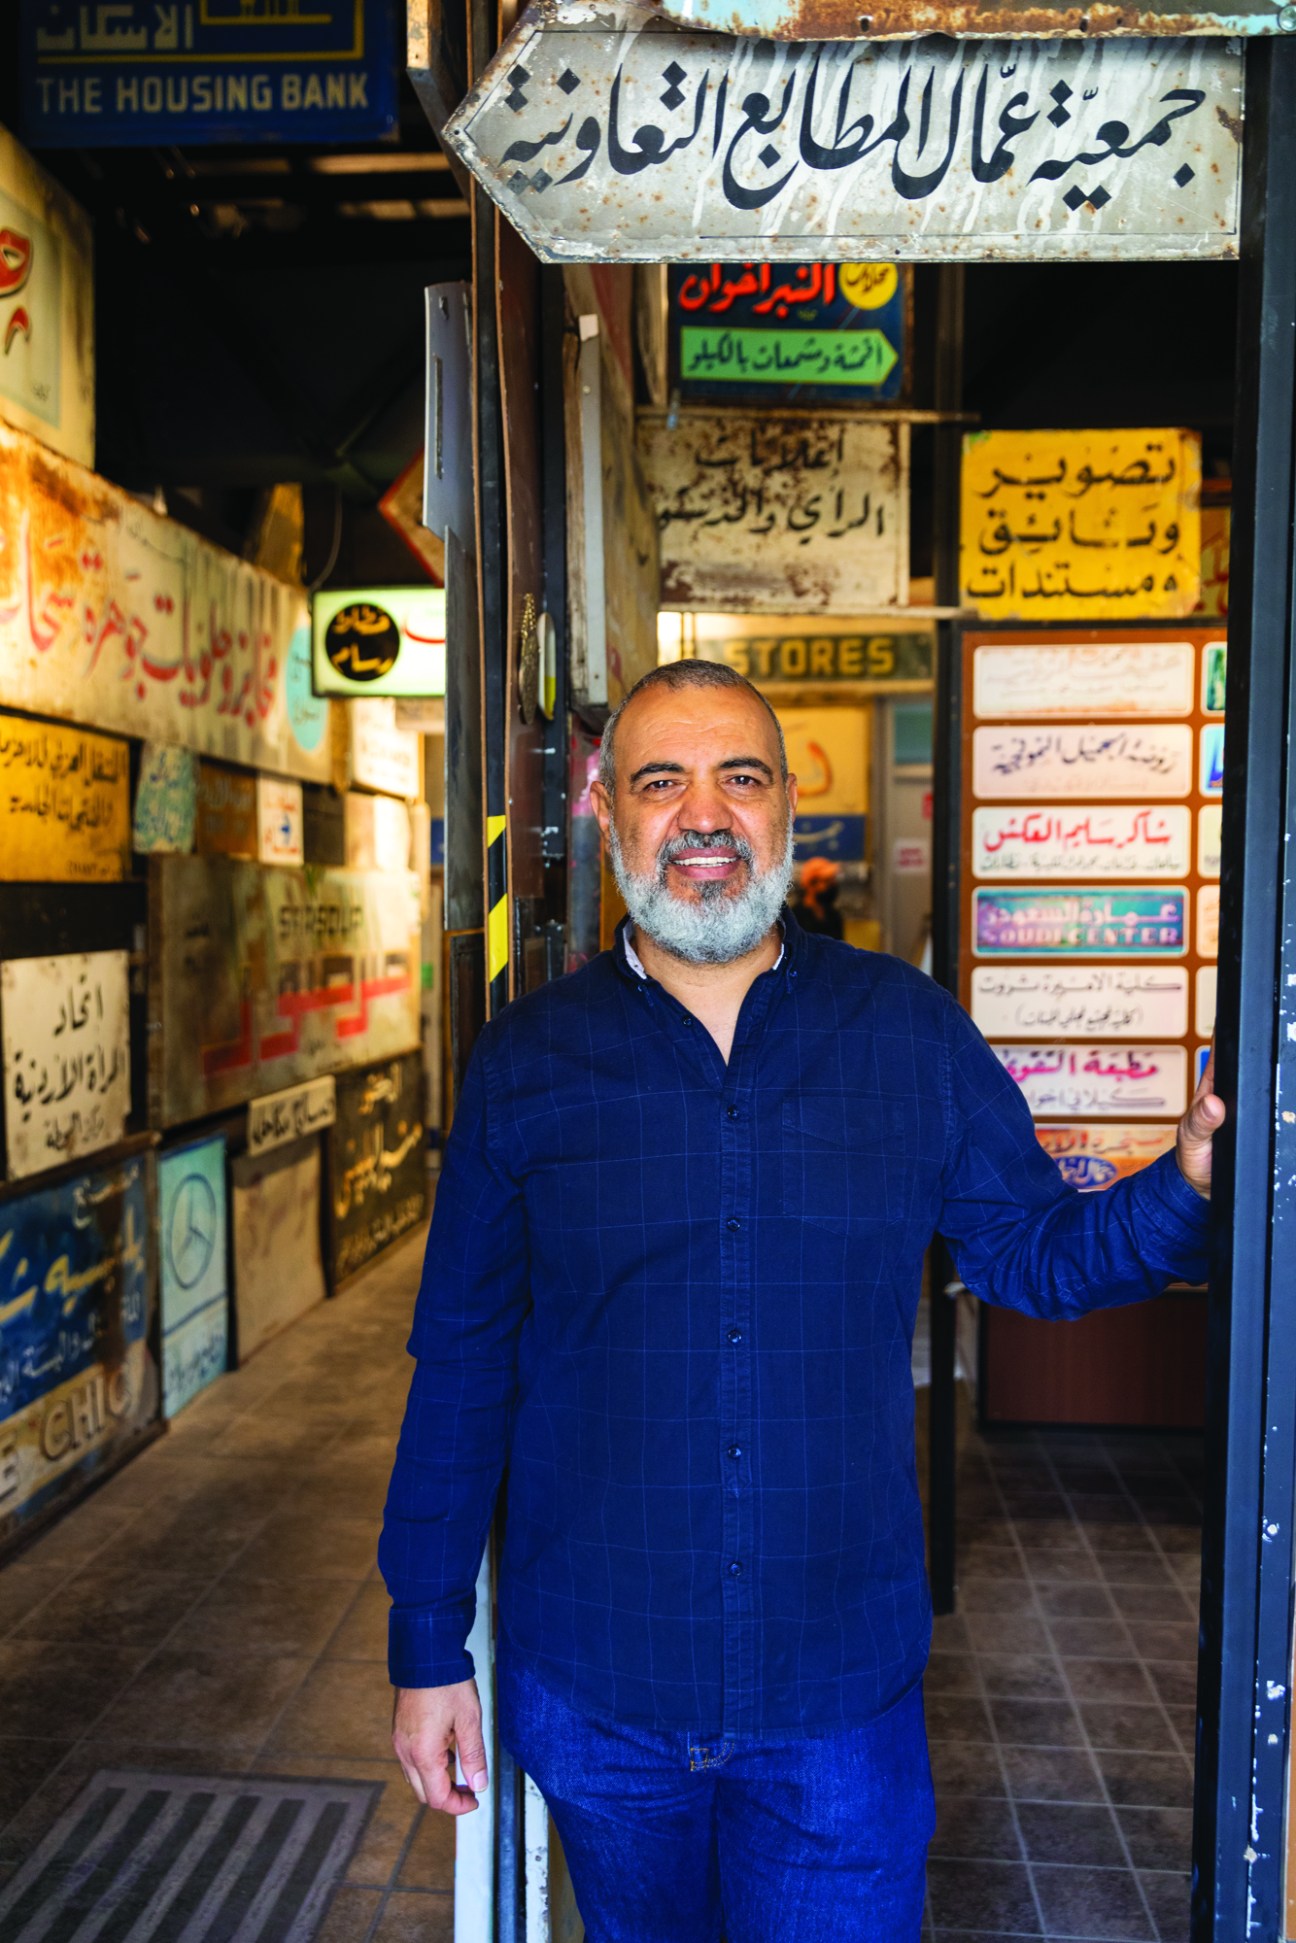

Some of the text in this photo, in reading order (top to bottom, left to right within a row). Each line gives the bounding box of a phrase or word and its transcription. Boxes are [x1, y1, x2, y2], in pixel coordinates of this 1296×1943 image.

[37, 73, 369, 113] THE HOUSING BANK
[499, 60, 728, 197] التعاونية
[724, 60, 938, 211] المطابع
[971, 443, 1177, 500] تصوير
[722, 636, 896, 678] STORES
[1063, 815, 1115, 850] سليم
[1115, 810, 1172, 848] شاكر
[981, 926, 1180, 946] SOUDI CENTER
[1116, 971, 1182, 997] كلية
